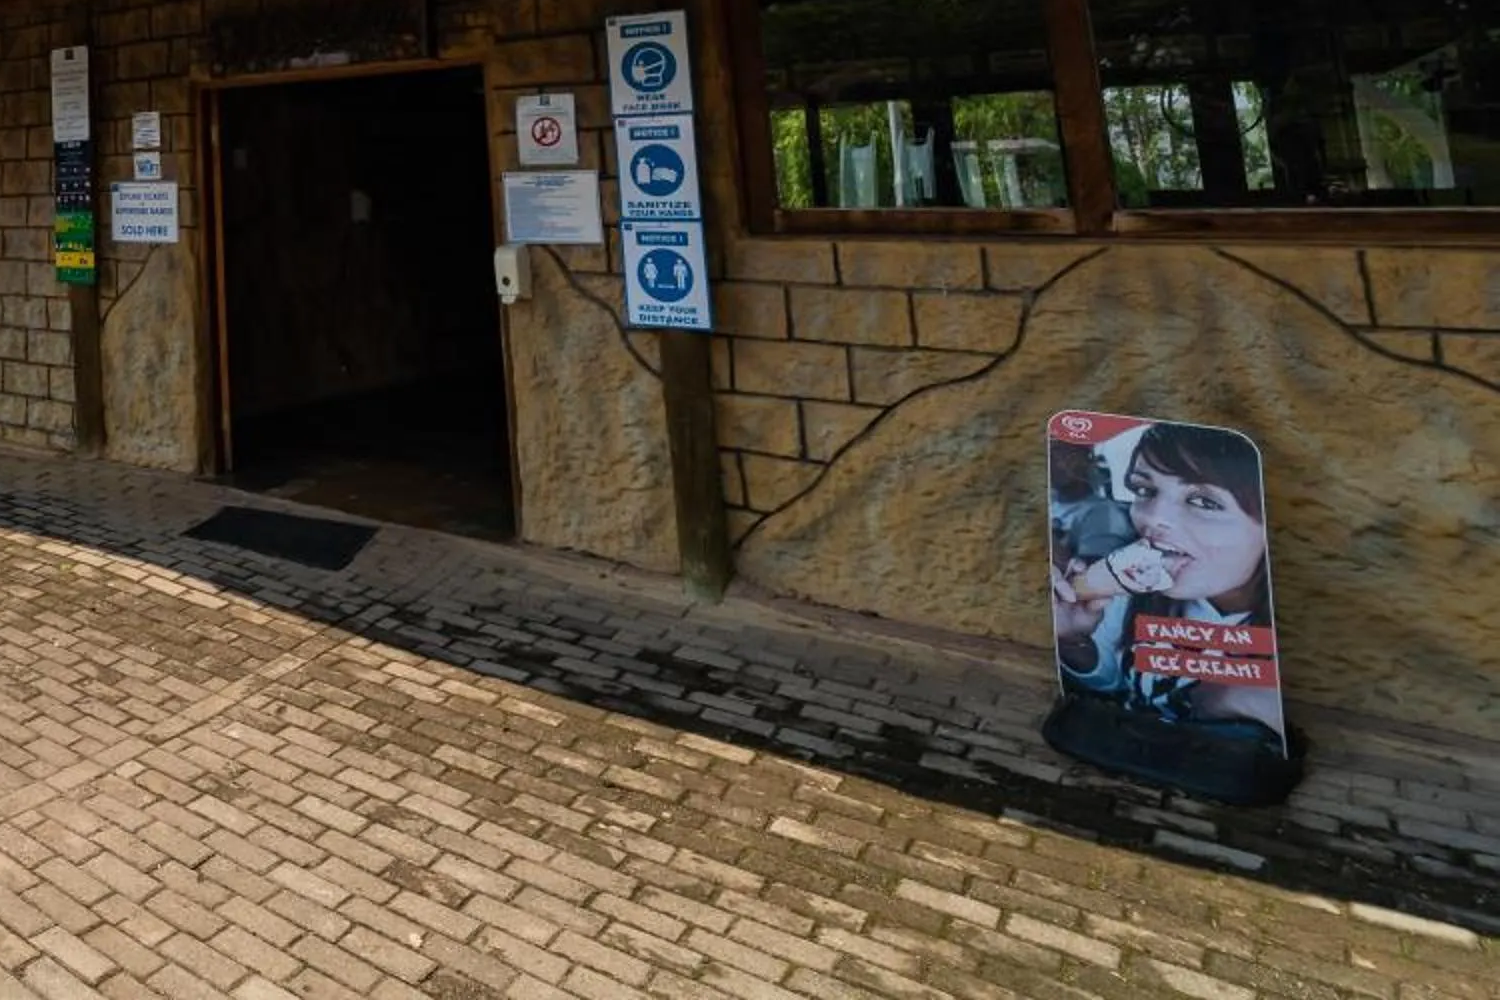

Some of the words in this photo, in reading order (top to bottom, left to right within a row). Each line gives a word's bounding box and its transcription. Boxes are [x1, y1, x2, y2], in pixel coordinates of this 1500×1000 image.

[633, 128, 668, 138] NOTICE
[628, 201, 692, 209] SANITIZE
[121, 224, 144, 236] SOLD
[146, 225, 168, 237] HERE
[638, 304, 665, 313] KEEP
[669, 306, 697, 314] YOUR
[639, 314, 698, 324] DISTANCE
[1146, 622, 1215, 642] FANCY
[1223, 629, 1253, 645] AN
[1148, 654, 1181, 671] ICE
[1185, 659, 1261, 679] CREAM?
